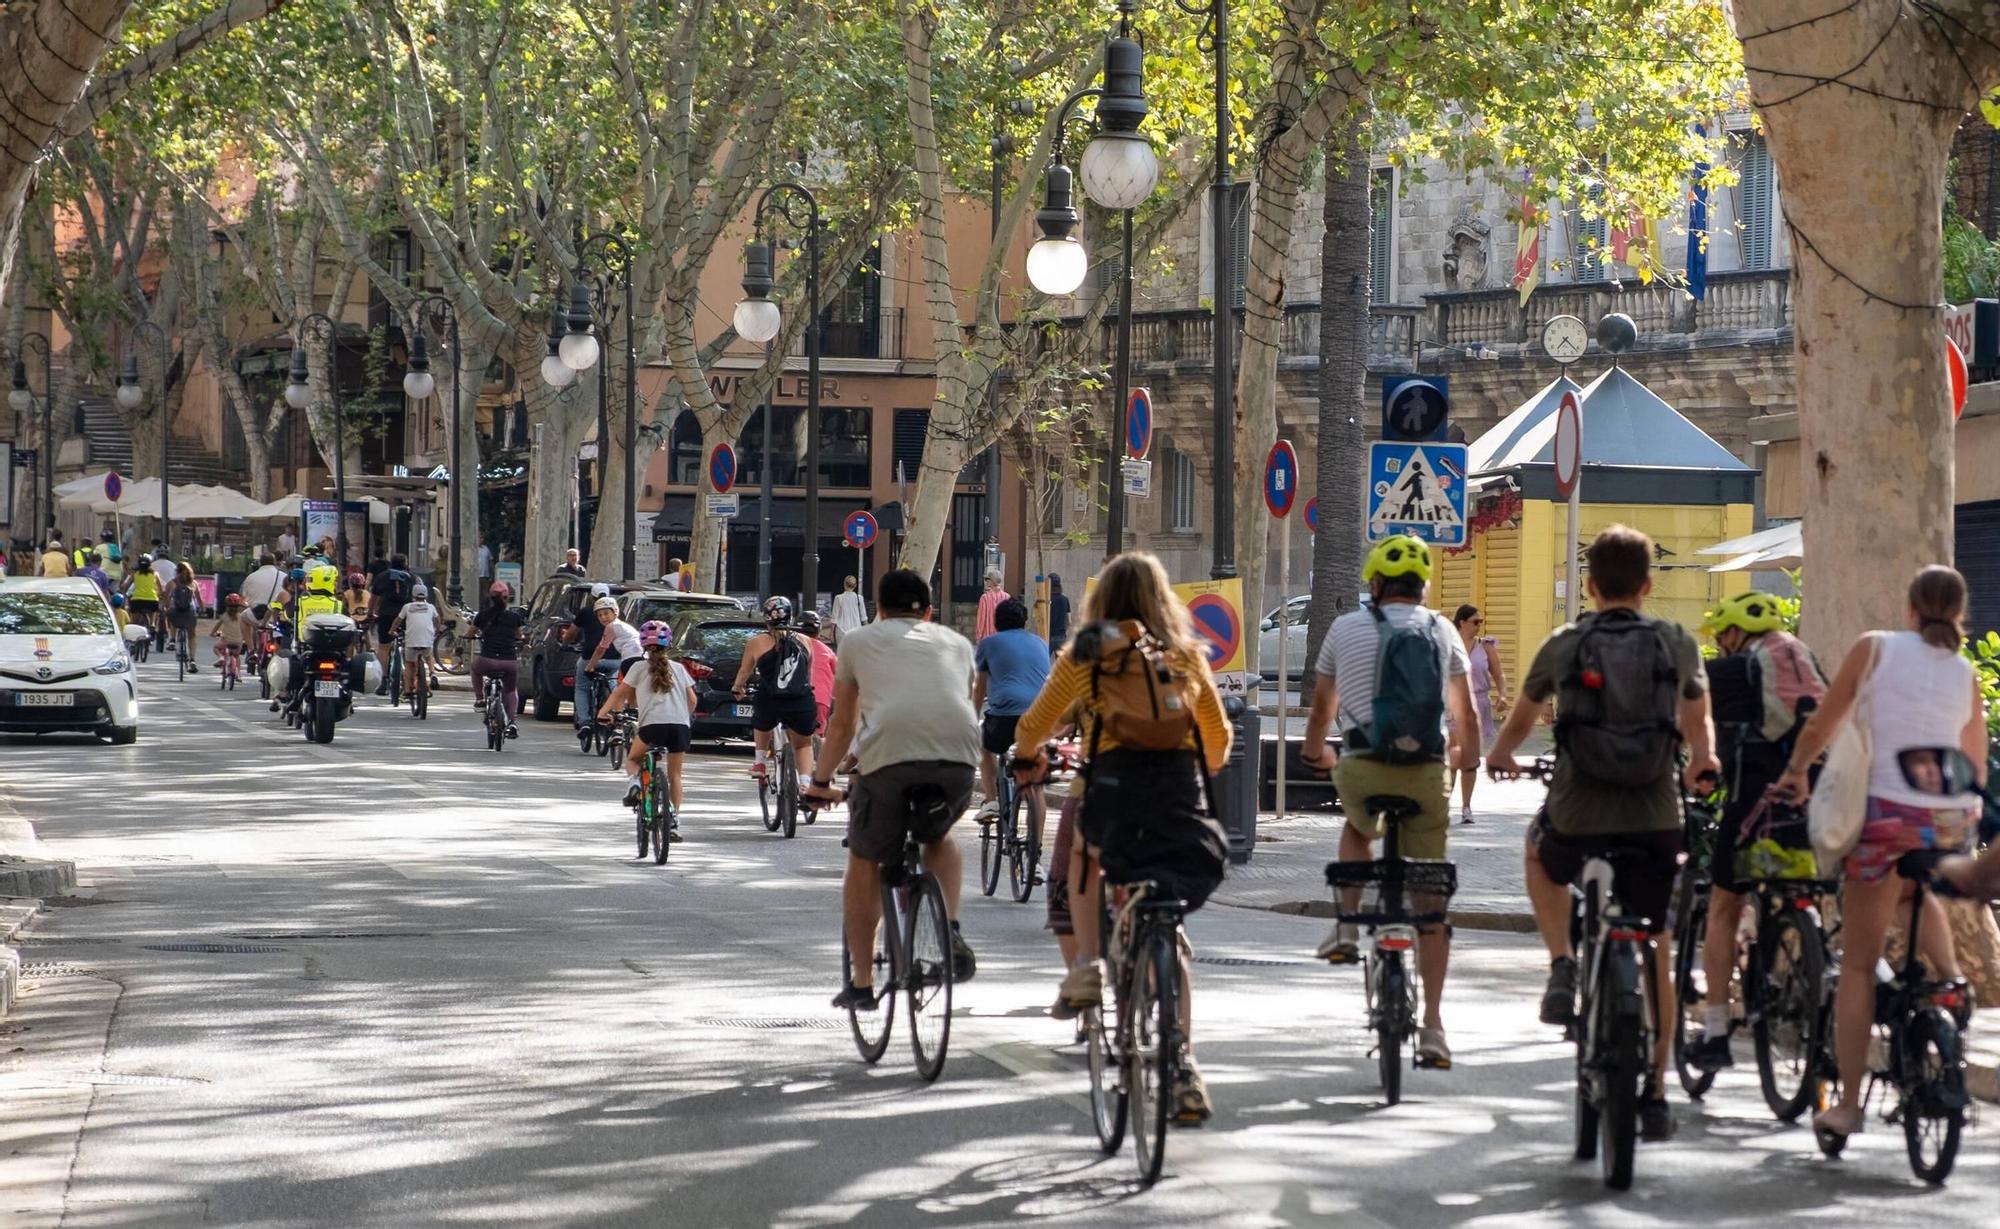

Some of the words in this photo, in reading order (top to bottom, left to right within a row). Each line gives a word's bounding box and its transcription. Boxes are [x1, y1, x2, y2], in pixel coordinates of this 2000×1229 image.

[710, 375, 841, 399] WLER
[23, 694, 49, 704] 1935
[53, 694, 72, 704] JTJ
[739, 706, 754, 715] 97
